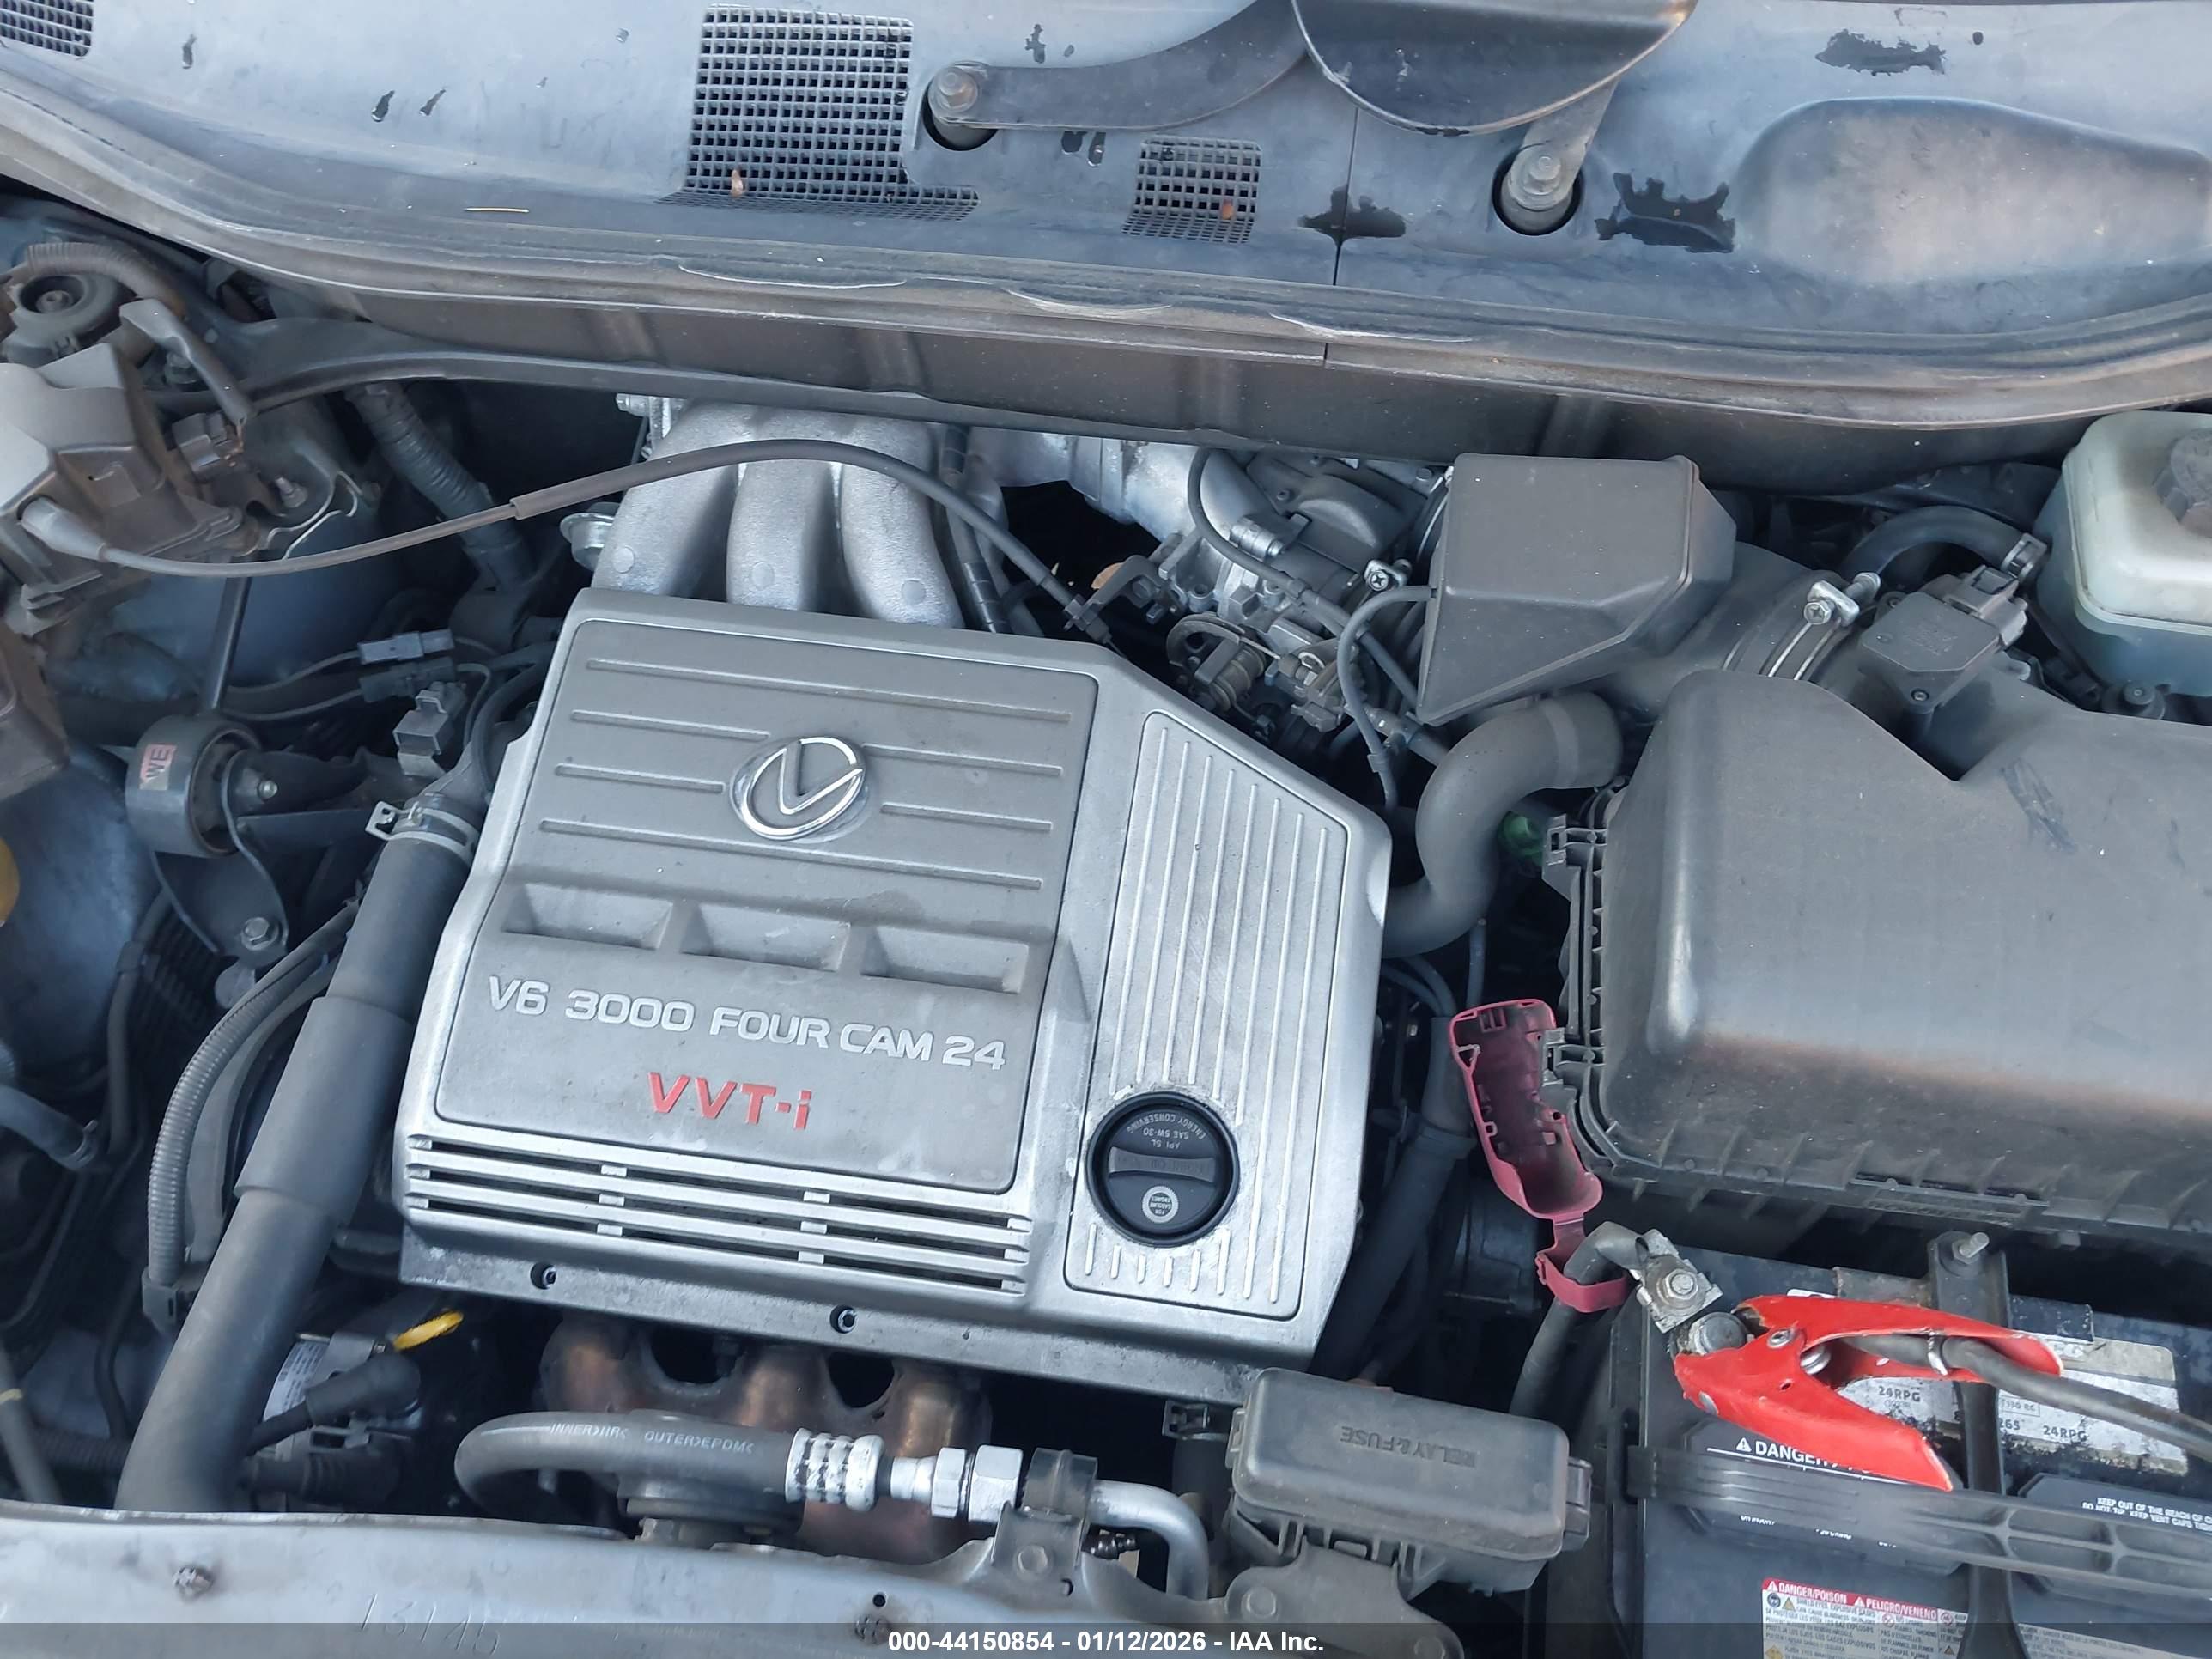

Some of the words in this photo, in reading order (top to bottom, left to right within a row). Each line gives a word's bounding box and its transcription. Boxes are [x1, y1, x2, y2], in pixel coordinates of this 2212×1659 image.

[488, 975, 550, 1016] V6
[564, 989, 695, 1032] 3000
[709, 1006, 830, 1049] FOUR
[839, 1023, 933, 1062] CAM
[941, 1035, 1006, 1071] 24
[647, 1071, 812, 1130] VVT-i
[1126, 1112, 1176, 1133] CONSERVING
[1177, 1116, 1206, 1139] ENERGY
[1143, 1127, 1170, 1138] 5W-30
[1173, 1130, 1189, 1139] SAE
[1166, 1140, 1181, 1149] API
[2042, 1425, 2088, 1443] 24RPG
[2096, 1497, 2116, 1507] KEEP
[2118, 1500, 2134, 1510] OUT
[2136, 1503, 2146, 1511] OF
[2148, 1505, 2164, 1516] THE
[2165, 1509, 2191, 1520] REACH
[2150, 1514, 2171, 1524] VENT
